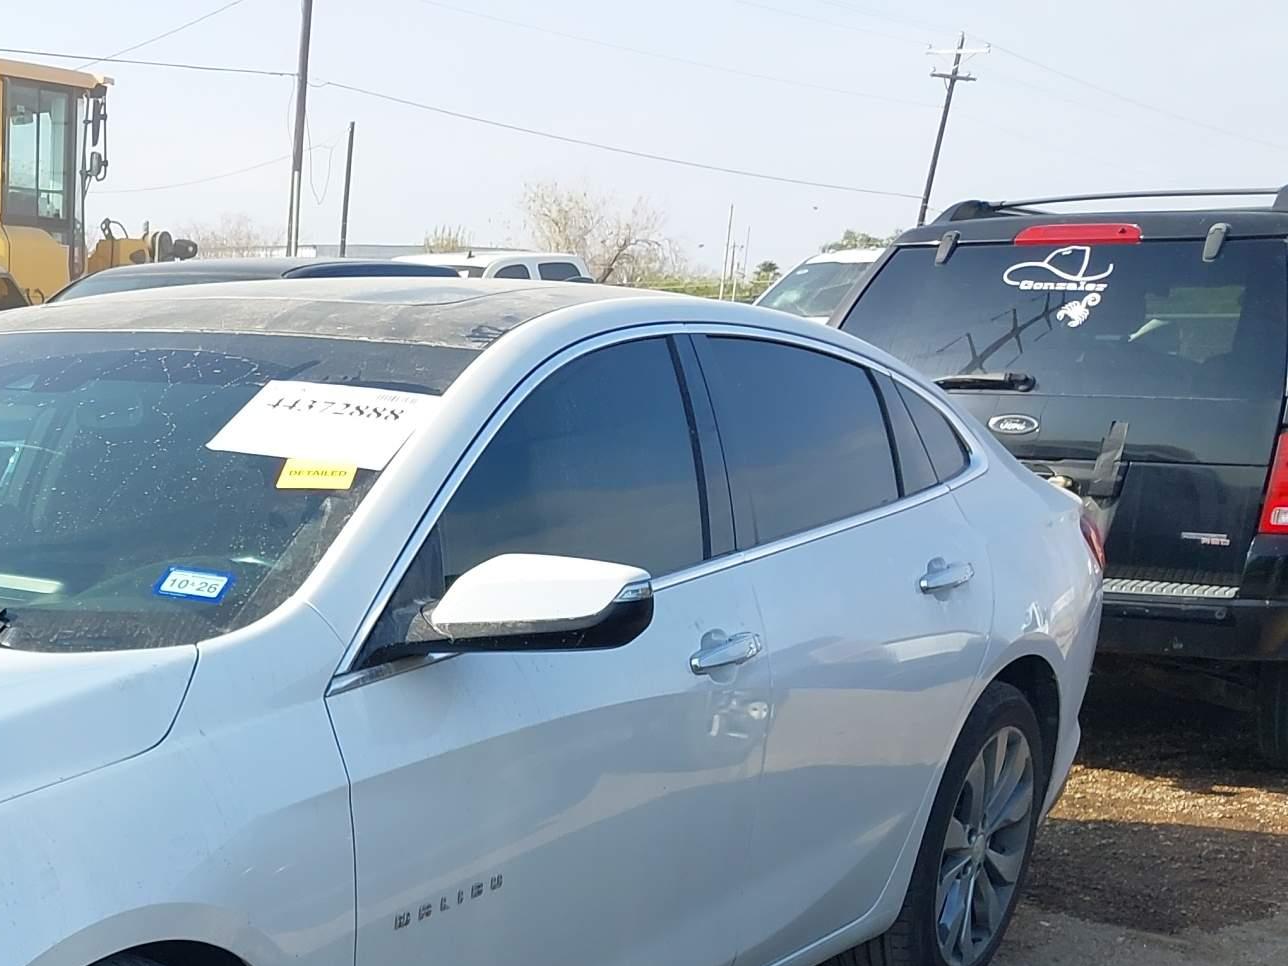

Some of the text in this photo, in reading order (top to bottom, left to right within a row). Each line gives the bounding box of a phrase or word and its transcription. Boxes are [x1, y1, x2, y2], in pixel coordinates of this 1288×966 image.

[1018, 279, 1109, 292] Gonzalez
[267, 397, 405, 421] 44372888
[999, 418, 1027, 432] Ford
[288, 470, 347, 478] DETAILED
[393, 873, 504, 930] MALIBU
